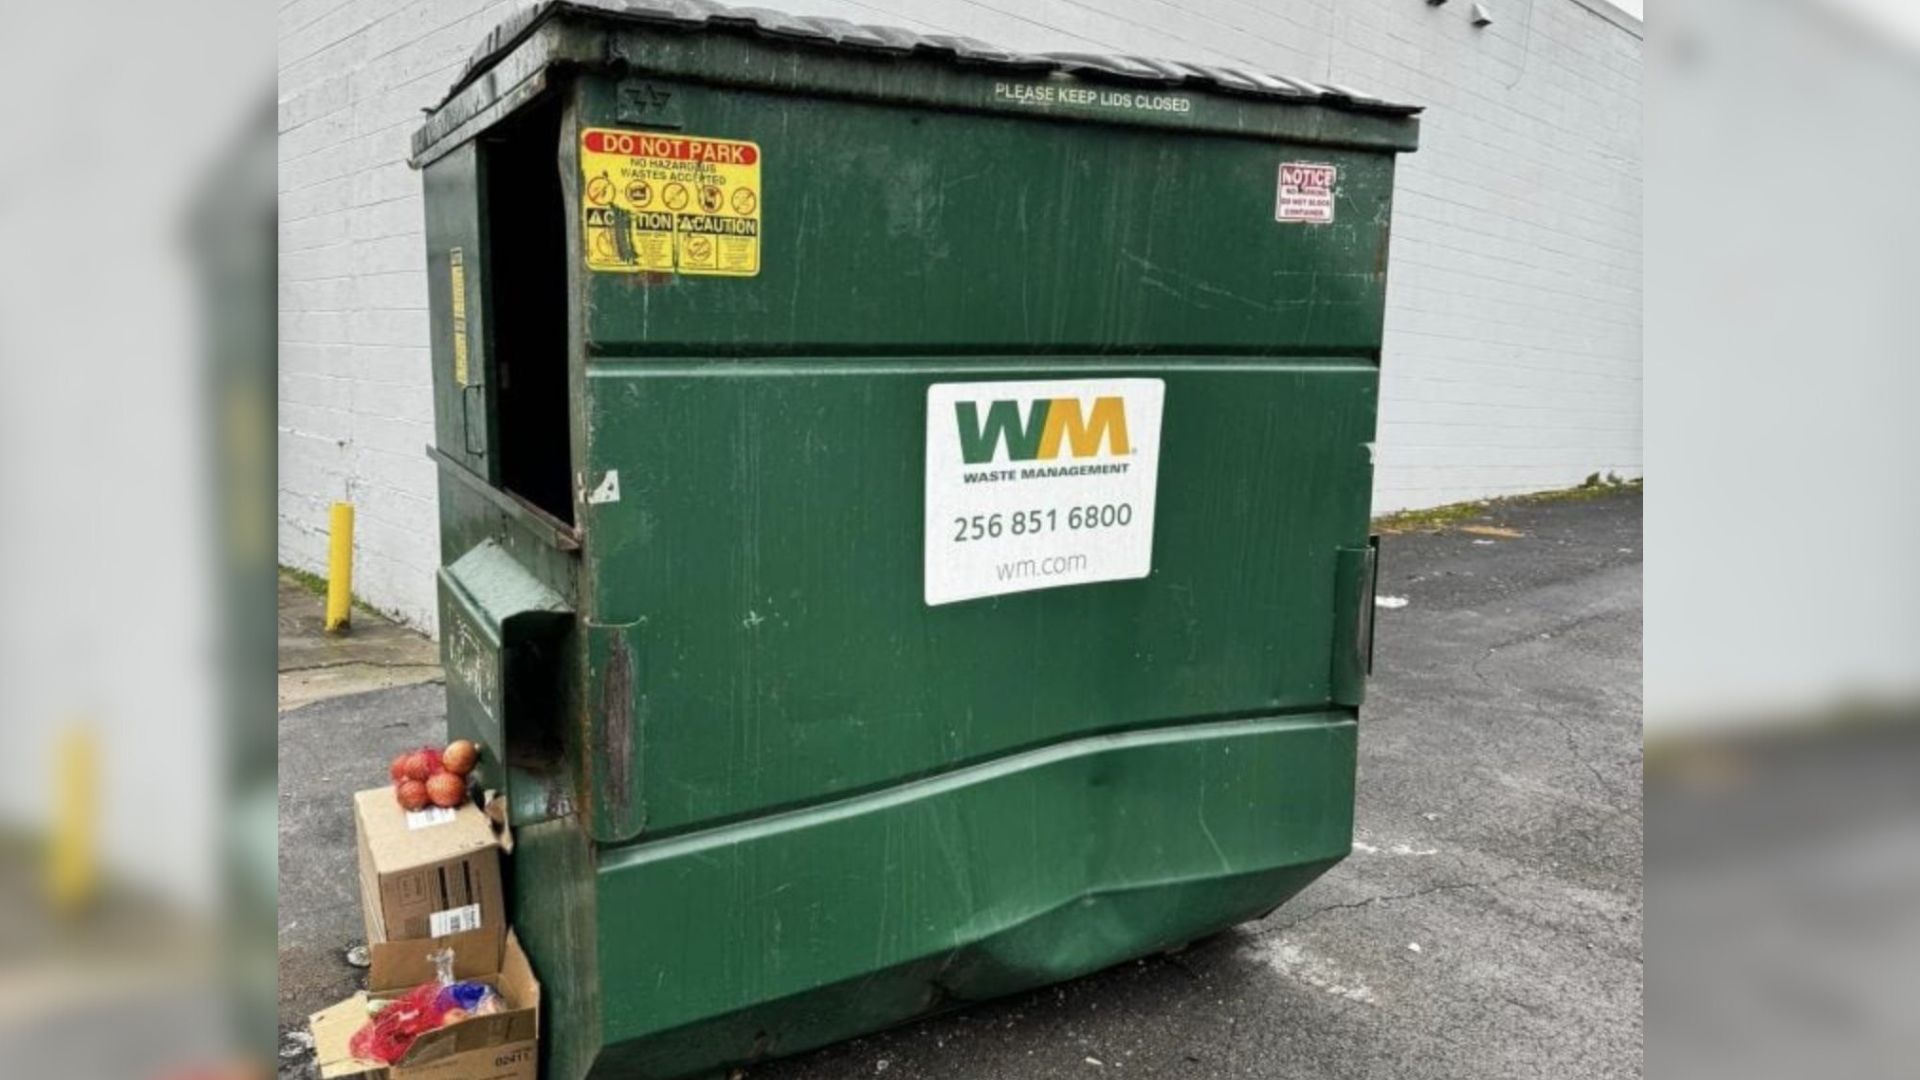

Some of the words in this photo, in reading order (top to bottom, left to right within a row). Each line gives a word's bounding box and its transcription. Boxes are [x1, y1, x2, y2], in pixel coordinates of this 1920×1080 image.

[995, 82, 1054, 101] PLEASE
[1058, 88, 1097, 104] KEEP
[1100, 91, 1132, 108] LIDS
[1135, 95, 1190, 112] CLOSED
[603, 134, 633, 153] DO
[640, 137, 683, 159] NOT
[689, 142, 746, 163] PARK
[620, 167, 667, 180] WASTES
[630, 158, 646, 168] NO
[1282, 168, 1333, 186] NOTICE
[603, 211, 672, 230] CTION
[694, 216, 756, 235] CAUTION
[954, 396, 1131, 465] WM
[963, 470, 1016, 484] WASTE
[1020, 463, 1131, 480] MANAGEMENT
[953, 514, 1003, 542] 256
[1011, 508, 1057, 535] 851
[1067, 503, 1133, 530] 6800
[996, 553, 1087, 581] wm.com
